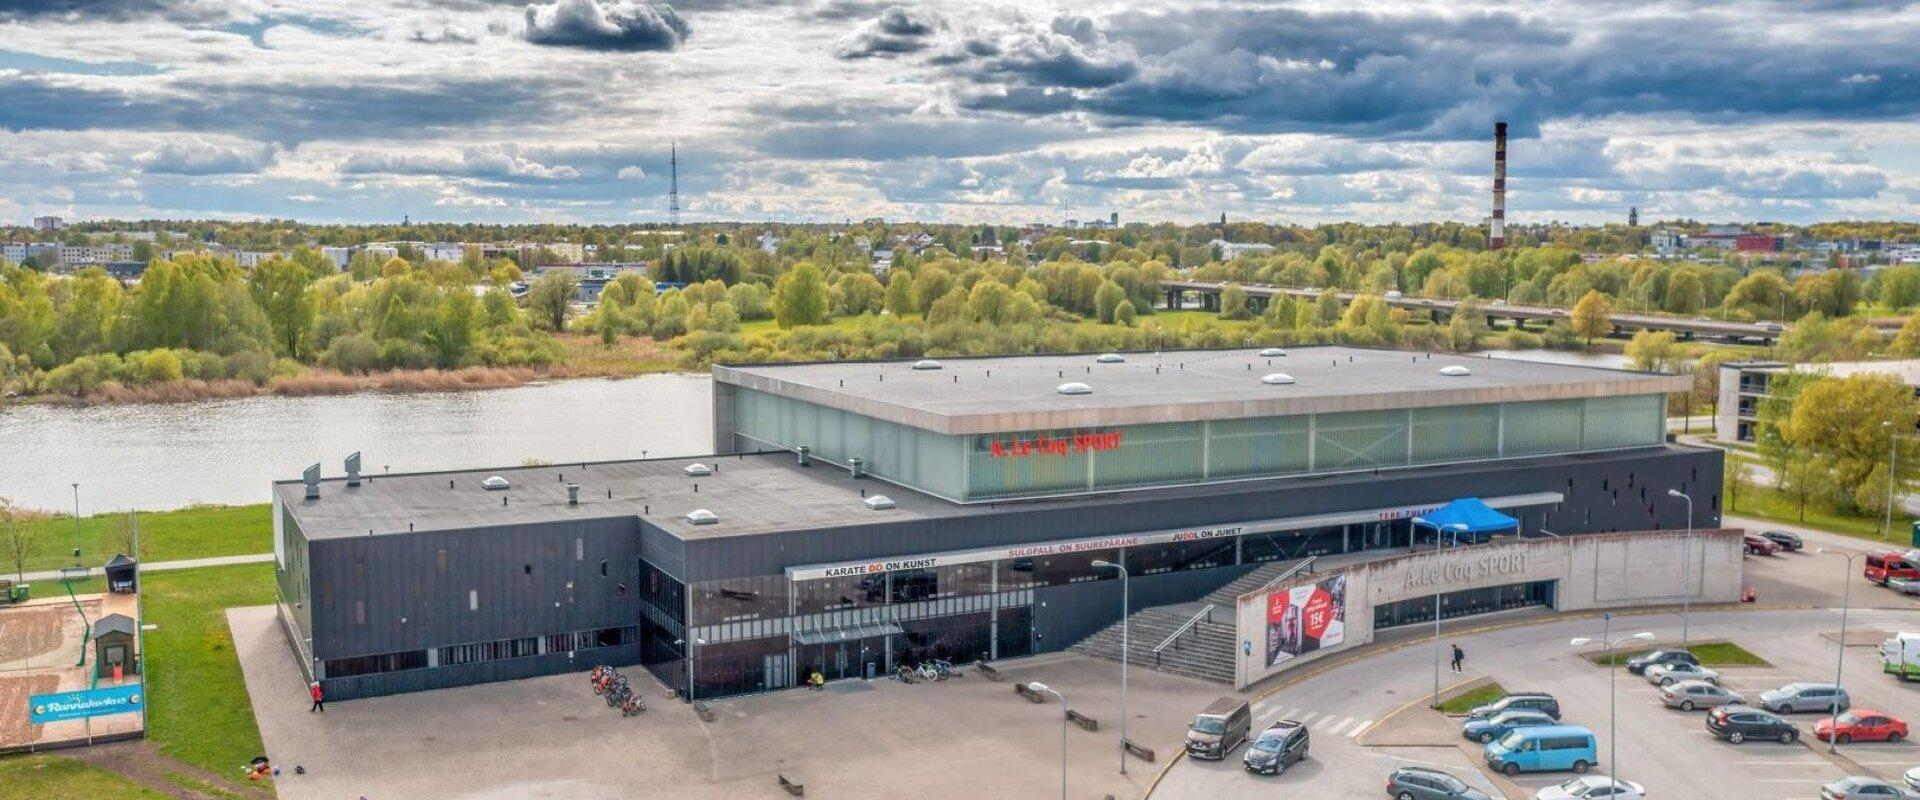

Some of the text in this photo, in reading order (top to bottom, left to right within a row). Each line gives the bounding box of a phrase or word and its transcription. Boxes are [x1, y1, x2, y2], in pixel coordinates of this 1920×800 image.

[1038, 435, 1068, 456] Coq
[1073, 432, 1122, 450] SPORT
[1201, 530, 1213, 538] ON
[1060, 544, 1072, 553] ON
[825, 558, 937, 577] KARATE DO ON KUNST
[1444, 561, 1474, 584] Coq
[1479, 551, 1531, 577] SPORT
